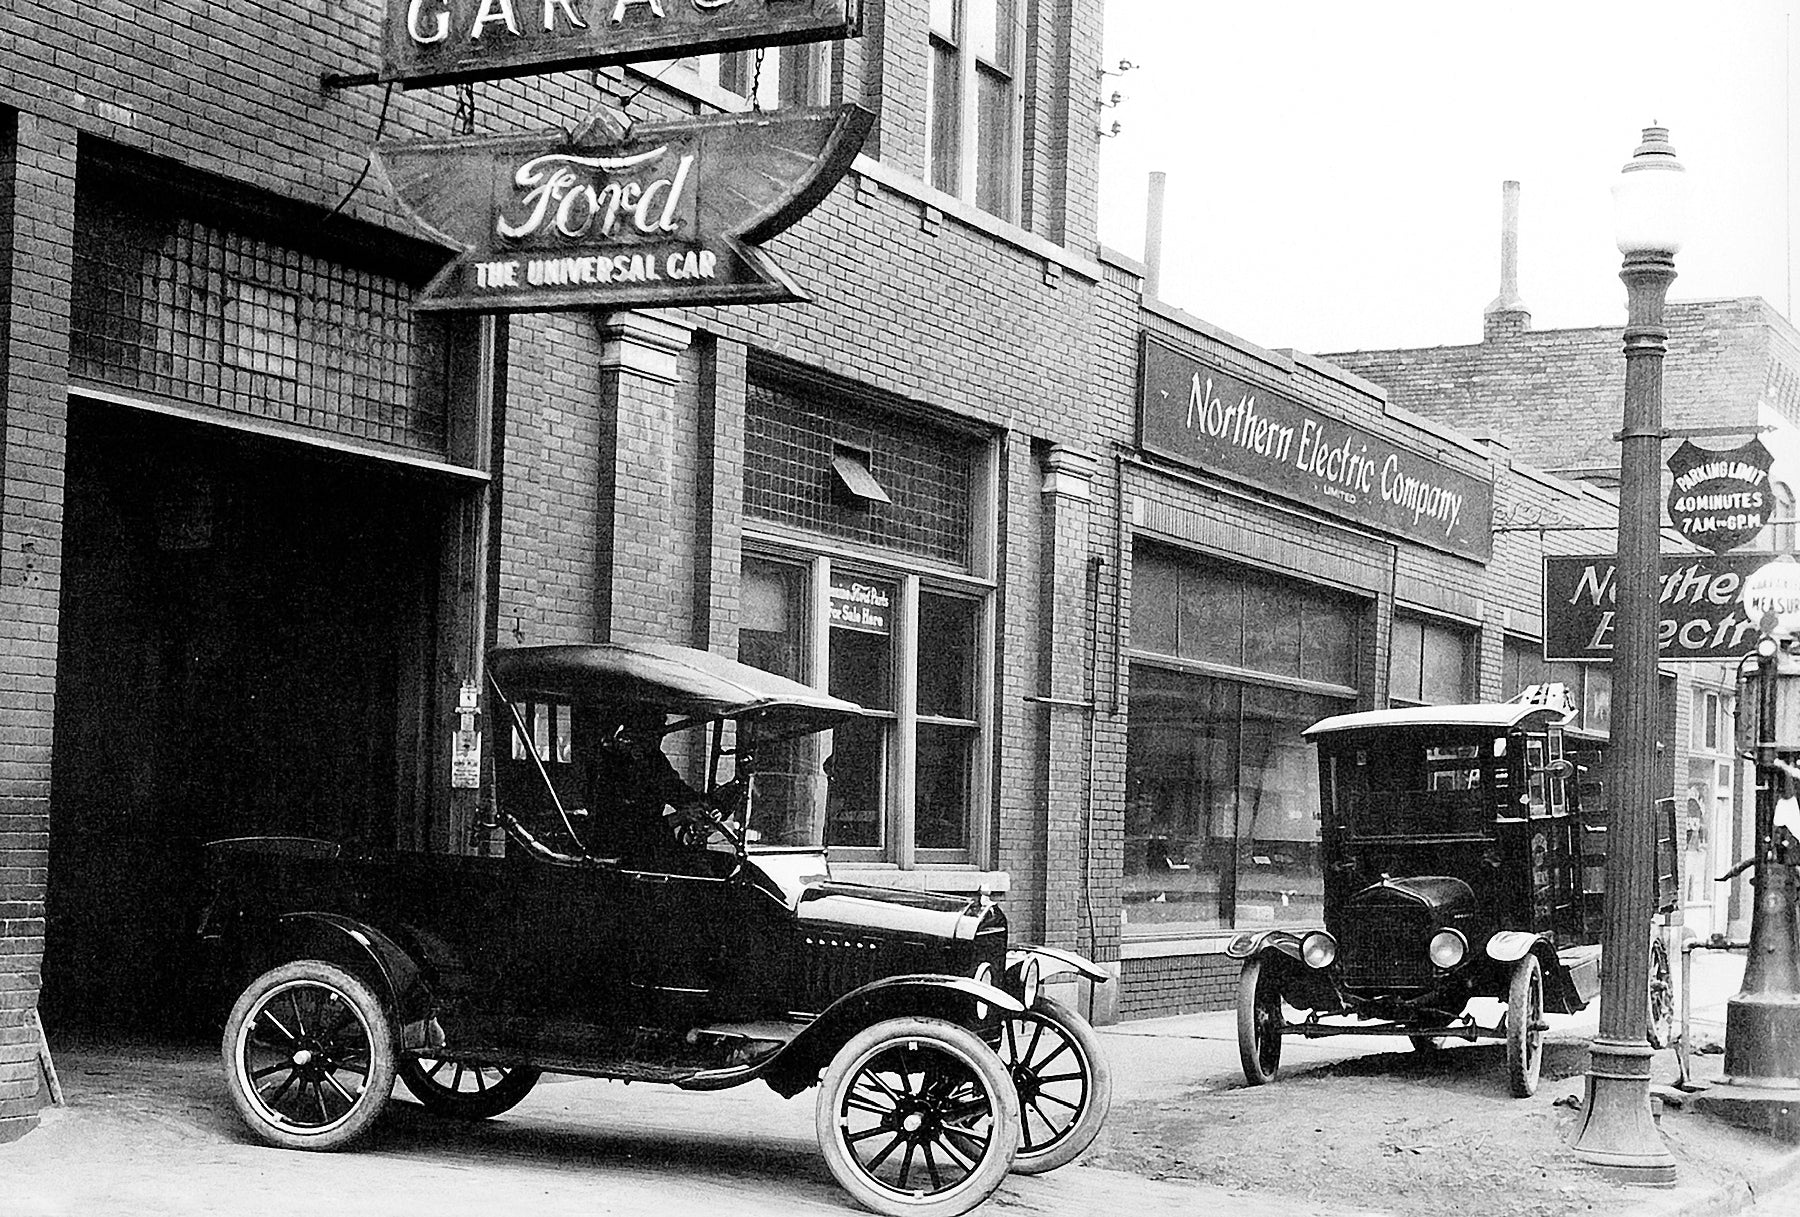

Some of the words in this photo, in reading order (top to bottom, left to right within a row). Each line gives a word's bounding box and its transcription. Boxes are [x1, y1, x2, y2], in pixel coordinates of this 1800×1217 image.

[407, 0, 736, 43] GAR
[497, 145, 694, 237] Ford
[475, 260, 520, 289] THE
[527, 254, 661, 286] UNIVERSAL
[667, 250, 717, 280] CAR
[1186, 371, 1294, 463] Northern
[1296, 418, 1375, 494] Electric
[1675, 461, 1728, 493] PARKING
[1728, 461, 1767, 487] LIMIT
[1674, 496, 1696, 513] 40
[1696, 491, 1763, 511] MINUTES
[850, 583, 871, 604] Ford
[1569, 563, 1748, 606] Nthe
[842, 605, 861, 623] Sale
[862, 608, 884, 627] Here
[1584, 611, 1761, 650] Eectr
